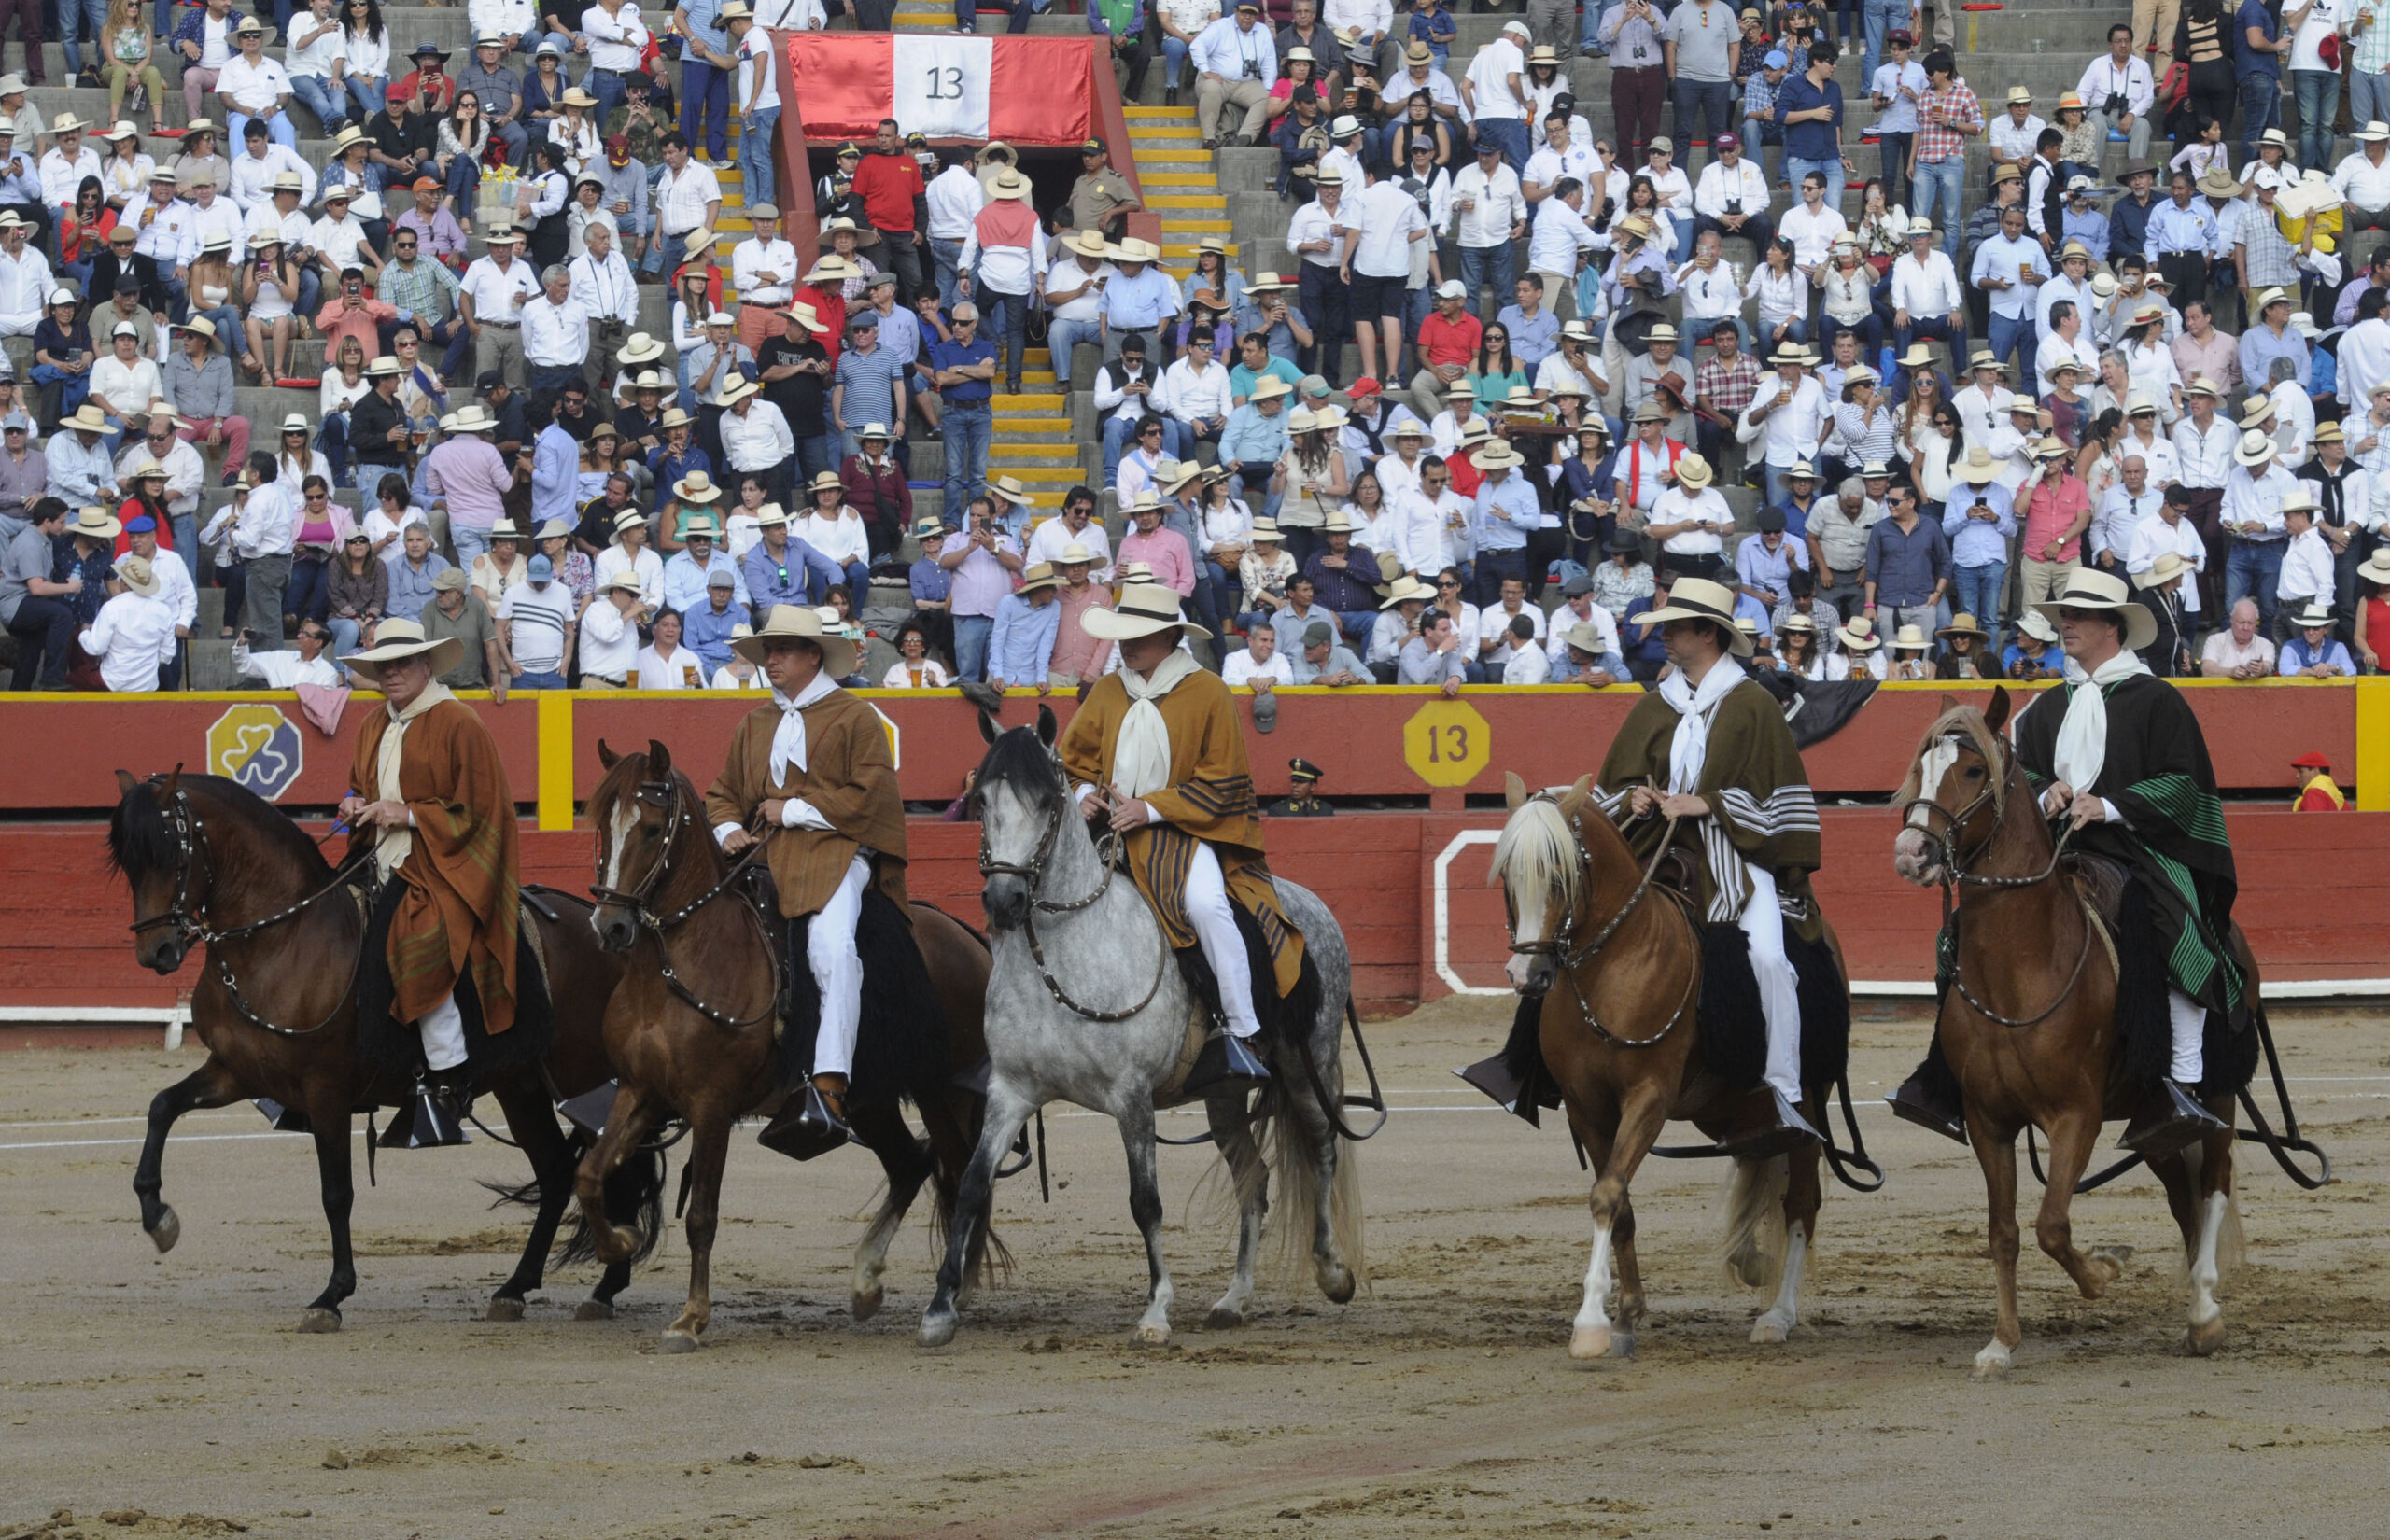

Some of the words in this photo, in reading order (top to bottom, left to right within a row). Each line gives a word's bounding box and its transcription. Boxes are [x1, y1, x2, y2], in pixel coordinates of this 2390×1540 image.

[926, 66, 964, 100] 13
[776, 350, 802, 359] TOMMY
[1428, 724, 1469, 763] 13
